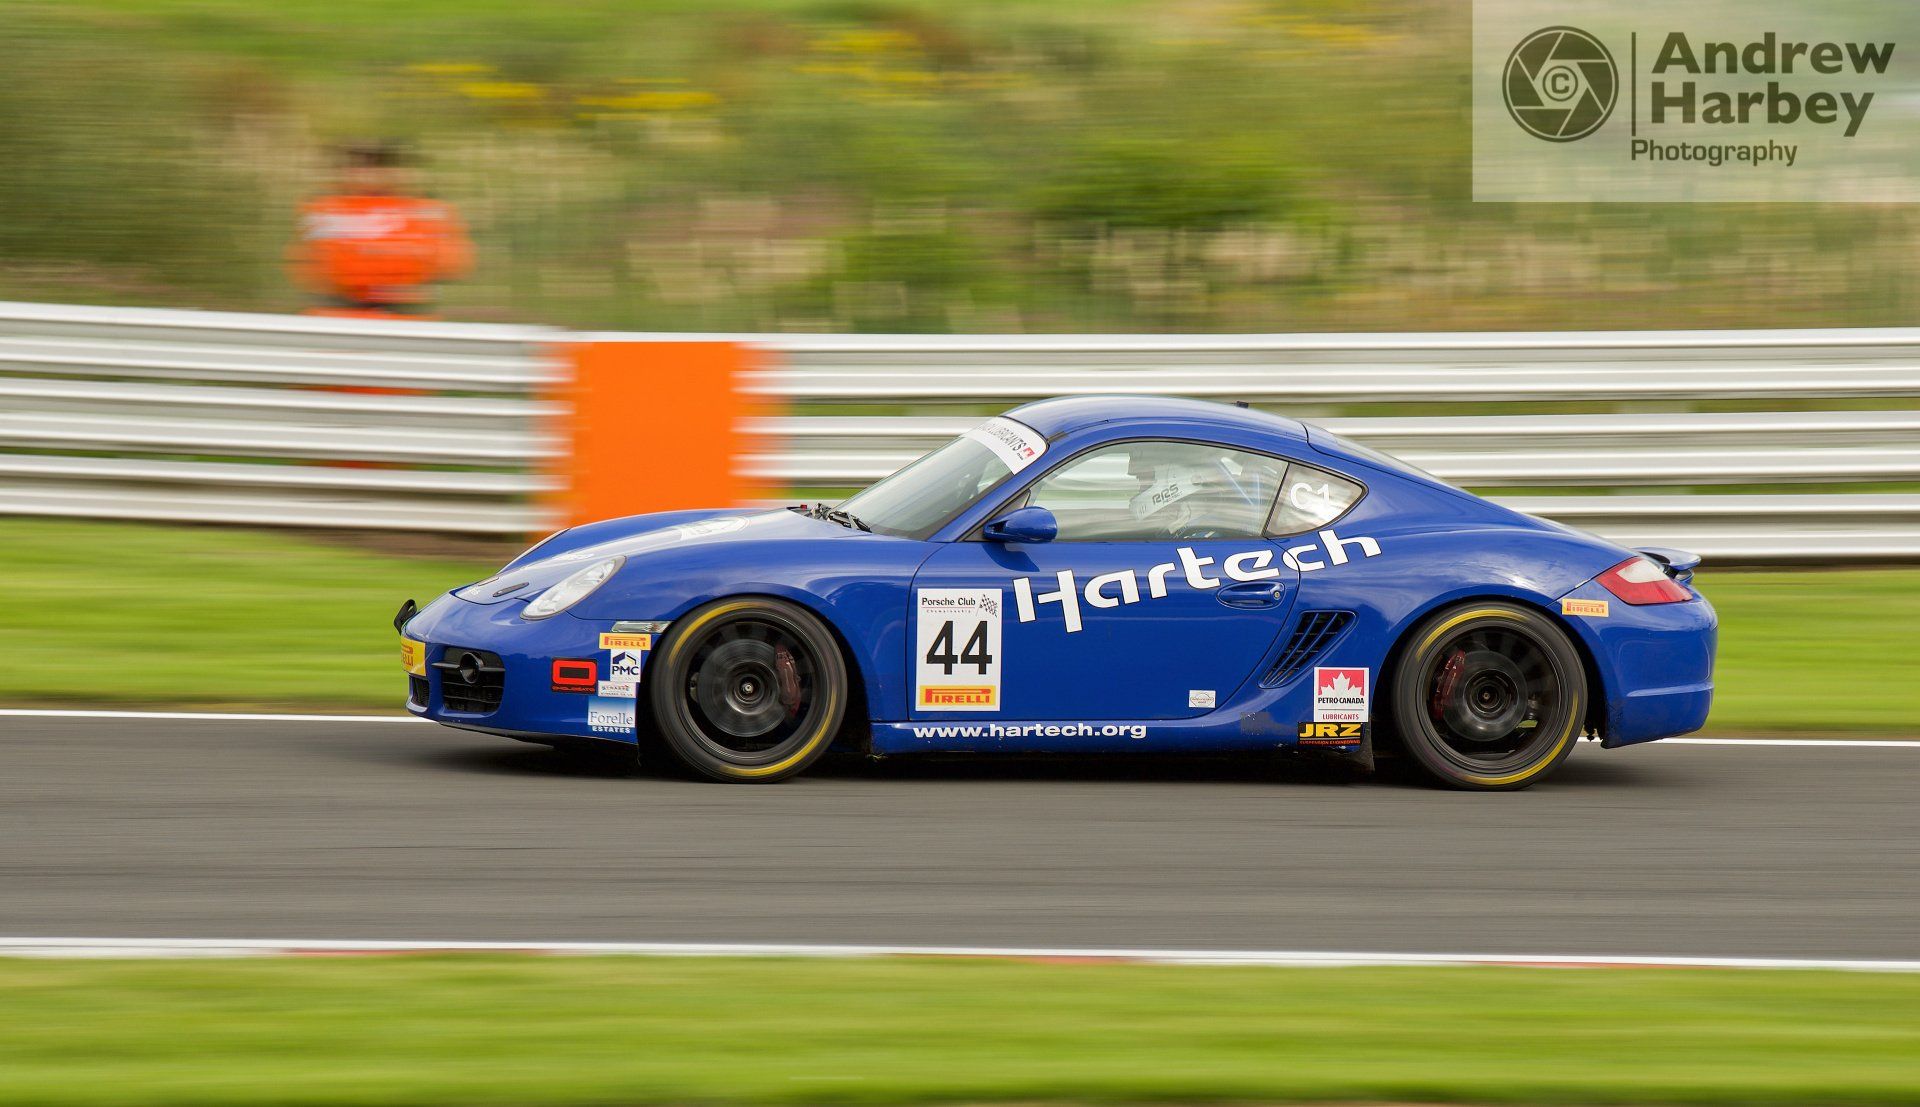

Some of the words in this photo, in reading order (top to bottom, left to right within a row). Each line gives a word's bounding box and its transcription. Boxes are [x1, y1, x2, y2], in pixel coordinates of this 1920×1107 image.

[1152, 484, 1179, 505] RRS
[1290, 482, 1330, 509] C1
[1012, 529, 1382, 633] Hartech
[921, 597, 955, 606] Porsche
[957, 597, 976, 606] Club
[1566, 601, 1605, 614] PIRELLI
[604, 636, 647, 647] PIRELLI
[926, 620, 993, 675] 44
[611, 665, 640, 676] PMC
[925, 688, 992, 704] PIRELLI
[590, 711, 634, 725] Forelle
[592, 725, 631, 734] ESTATES
[913, 722, 1148, 739] www.hartech.org
[1300, 723, 1361, 737] JRZ
